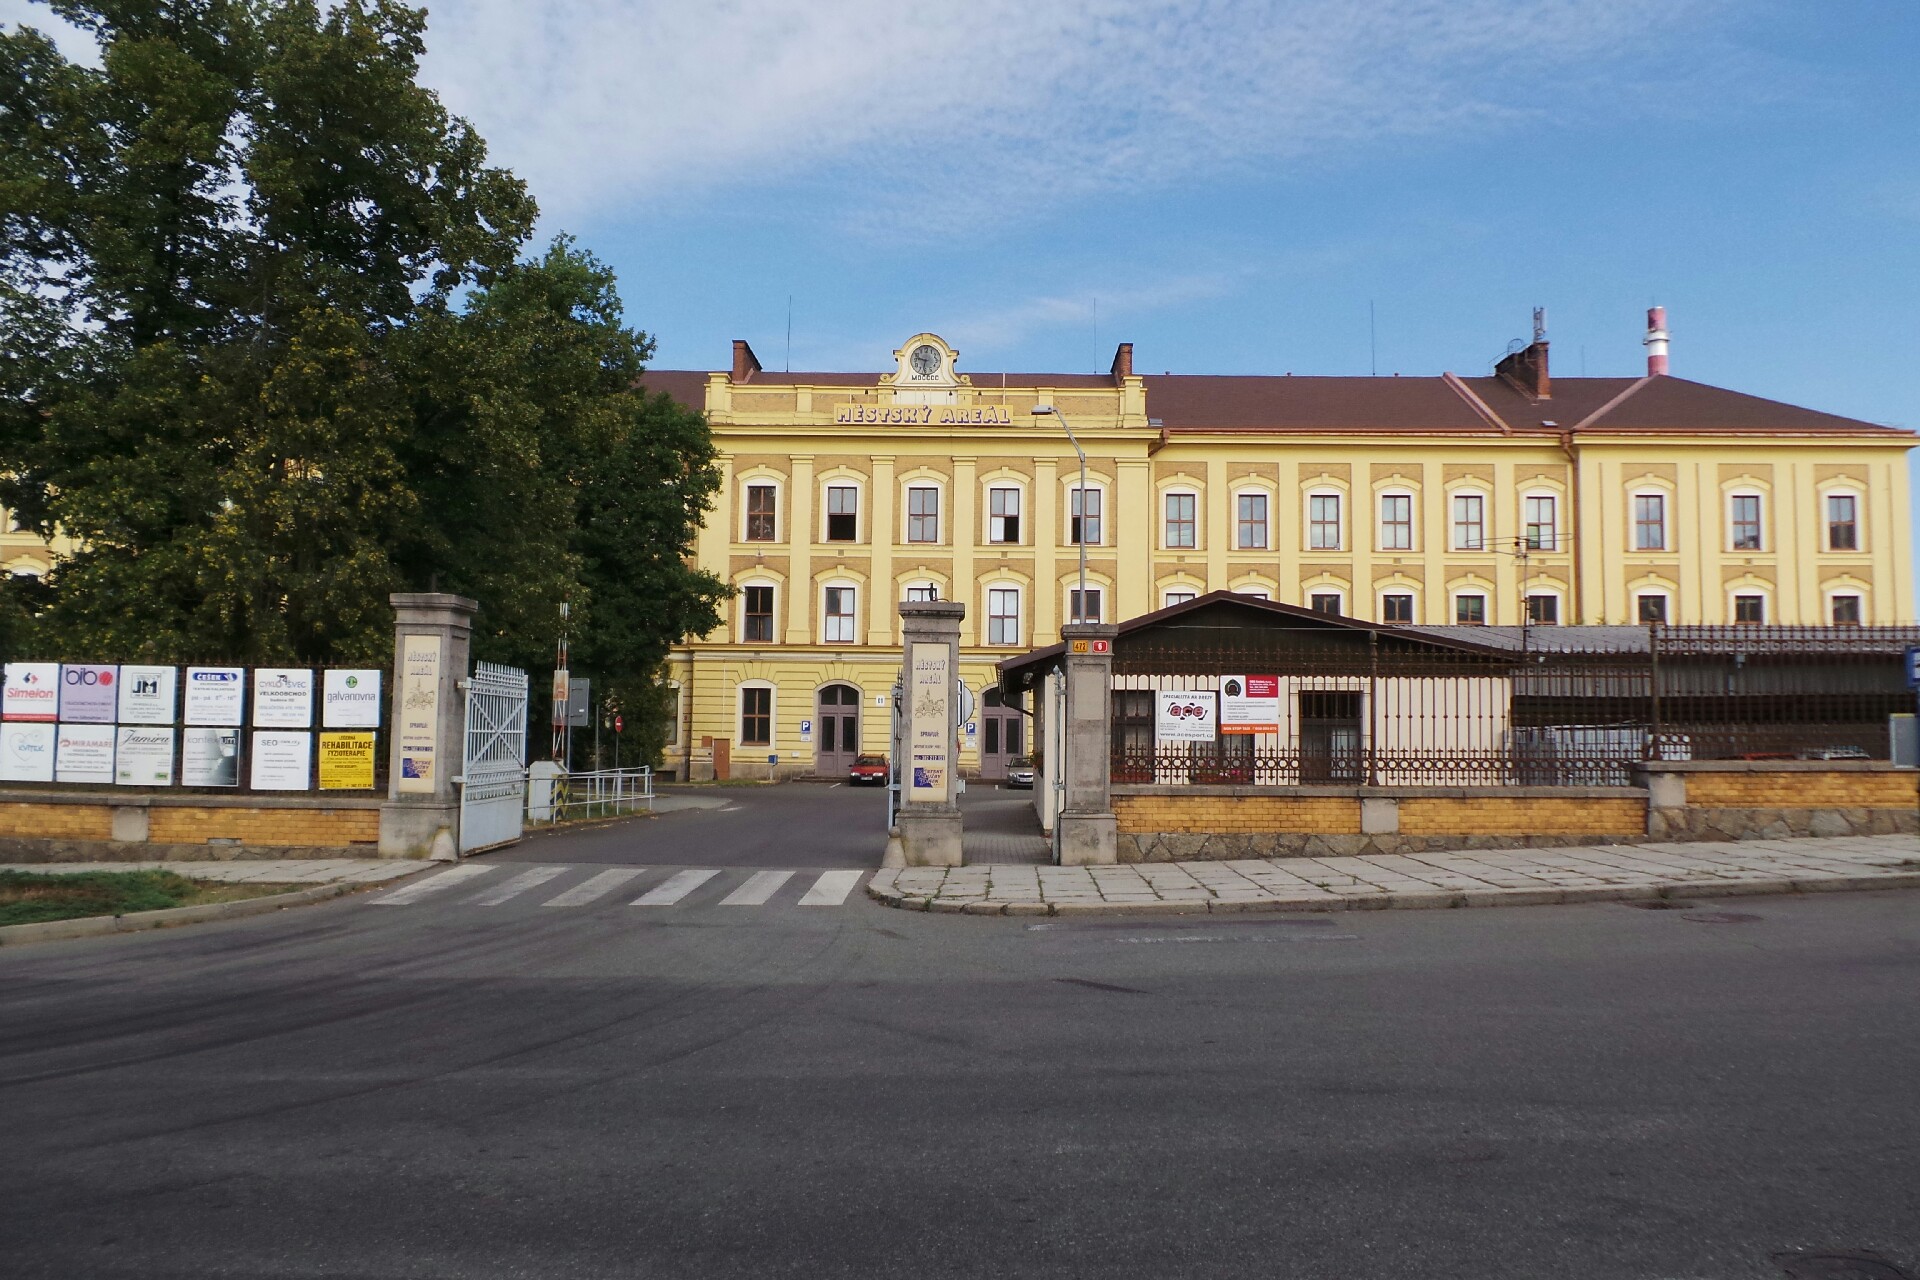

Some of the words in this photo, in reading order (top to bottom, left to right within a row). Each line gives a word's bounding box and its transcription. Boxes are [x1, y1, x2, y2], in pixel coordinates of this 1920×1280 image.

[837, 404, 932, 424] MĚSTSKÝ
[940, 406, 1011, 424] AREÁL
[132, 680, 157, 694] JM
[328, 691, 376, 704] galvanovna
[1170, 706, 1204, 717] ace
[72, 739, 112, 748] MIRAMARE
[322, 741, 373, 750] REHABILITACE
